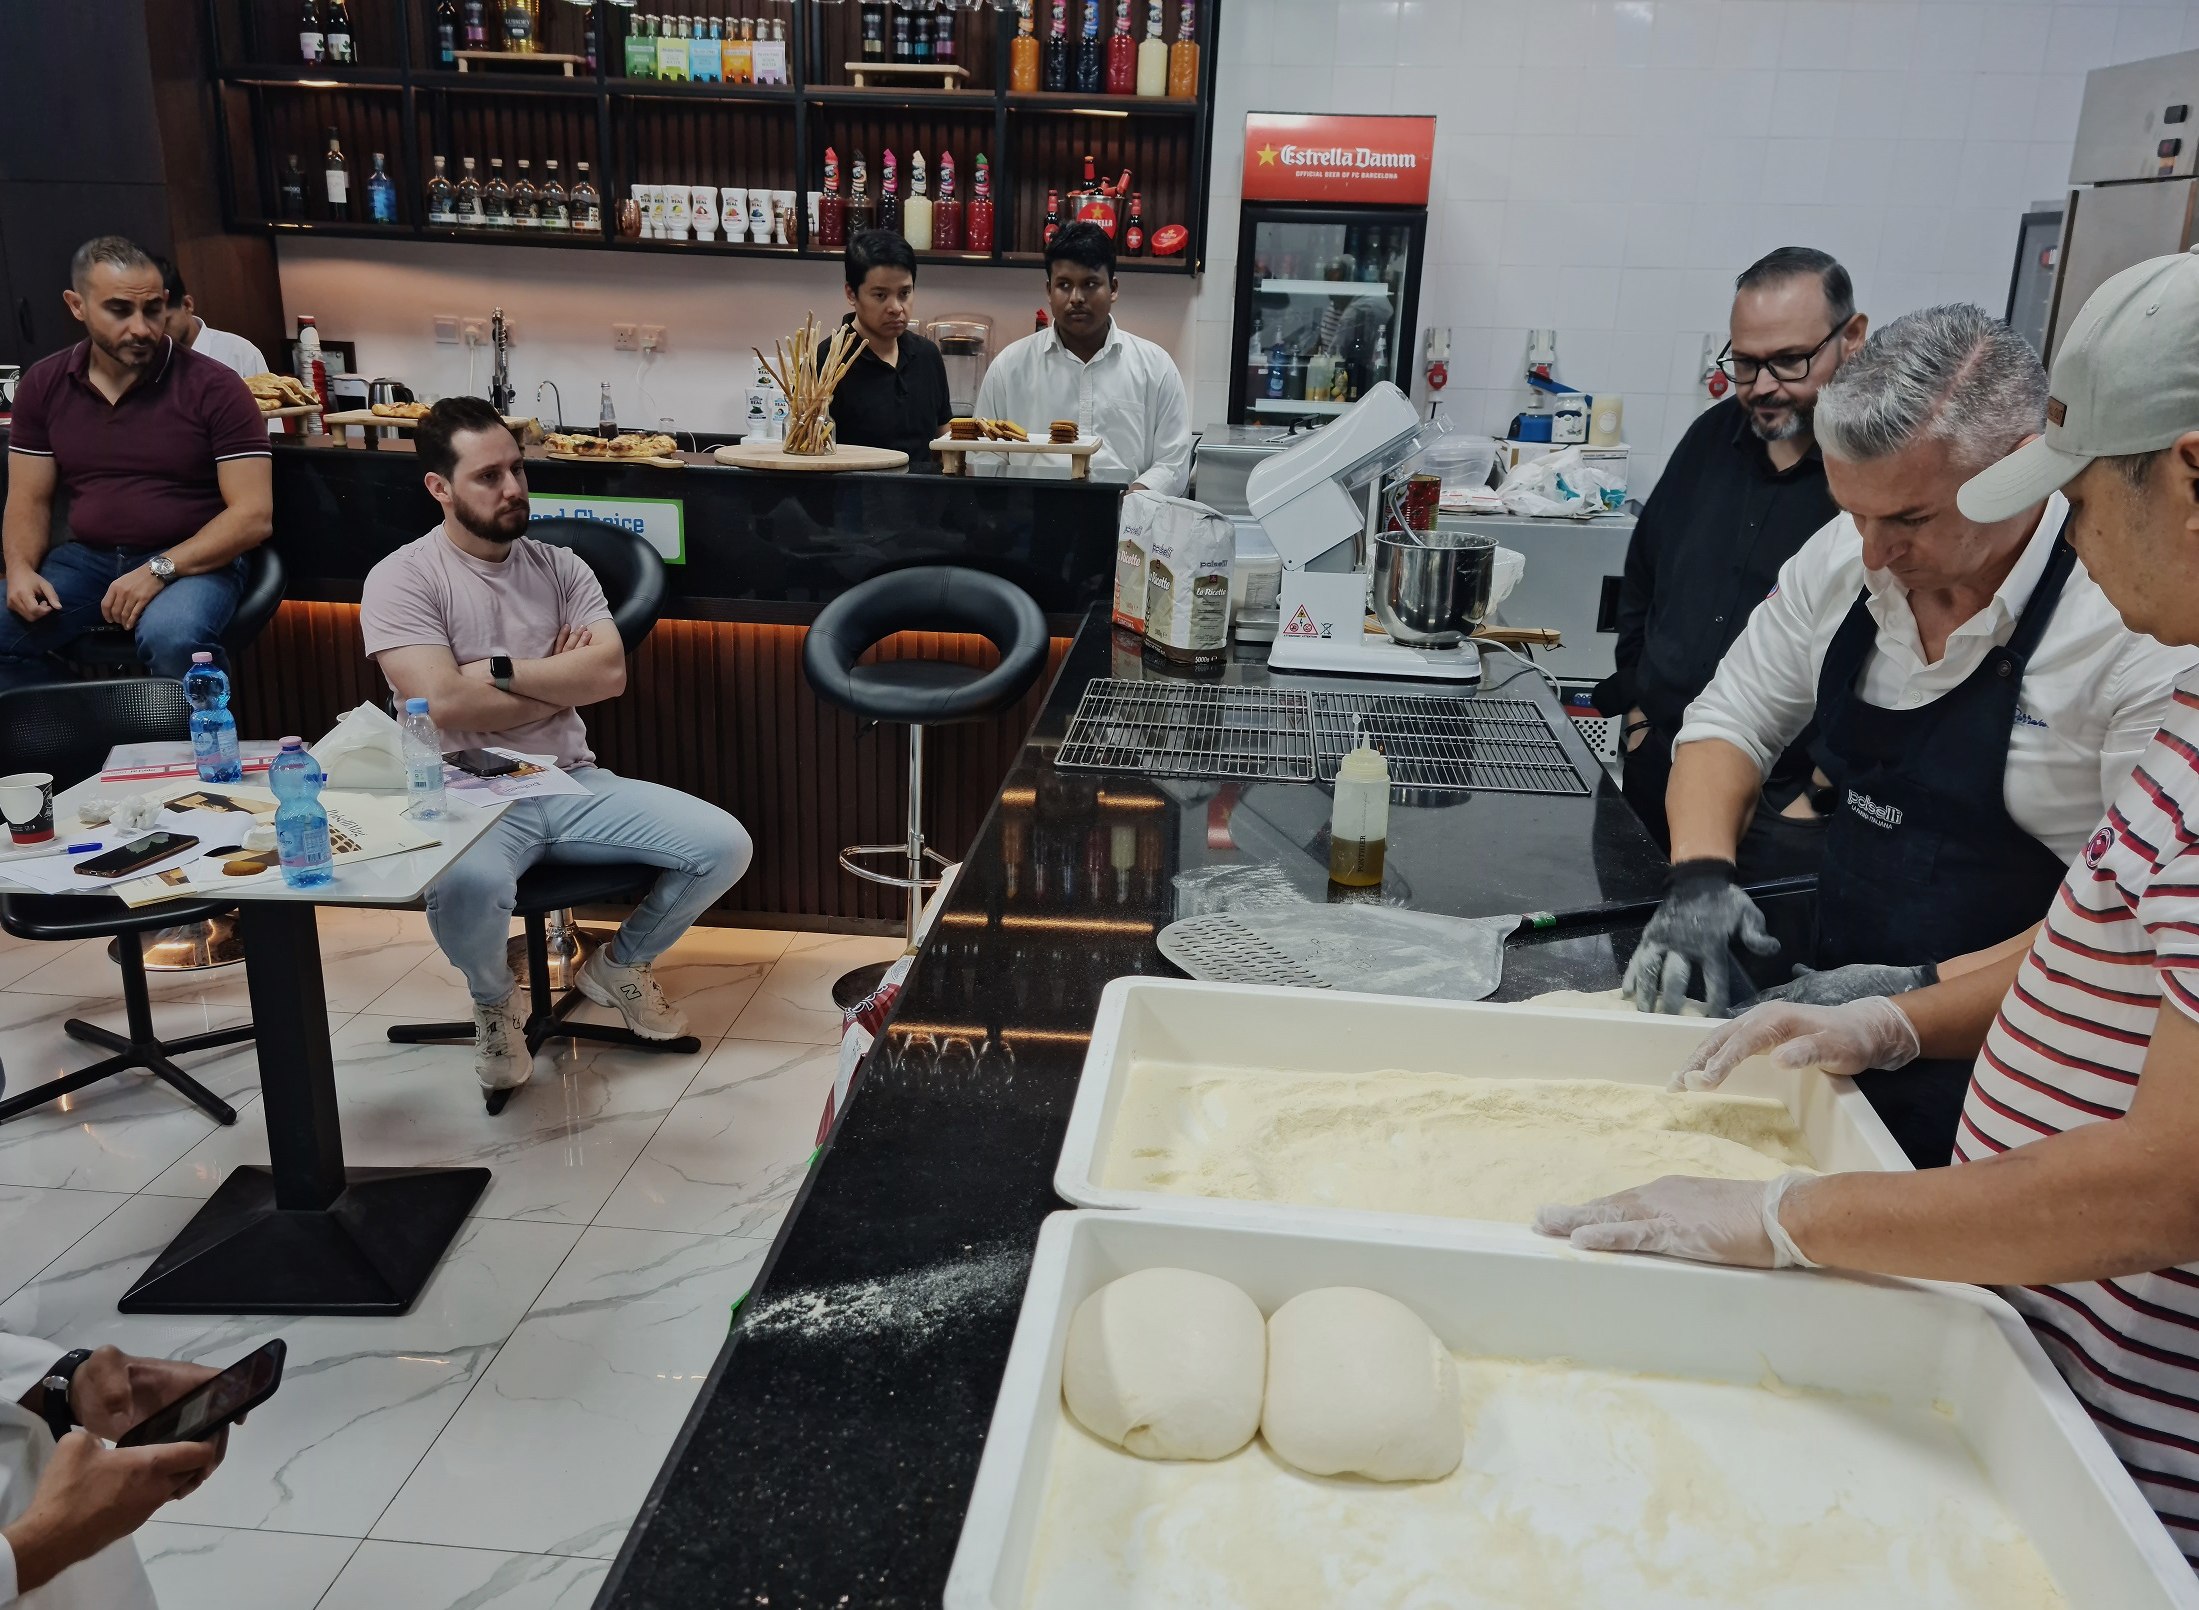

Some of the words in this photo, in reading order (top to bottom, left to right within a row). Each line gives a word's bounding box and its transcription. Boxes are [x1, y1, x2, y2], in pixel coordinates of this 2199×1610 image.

[1280, 144, 1353, 167] Estrella
[1354, 147, 1417, 169] Damm
[1080, 218, 1113, 227] TRELLA
